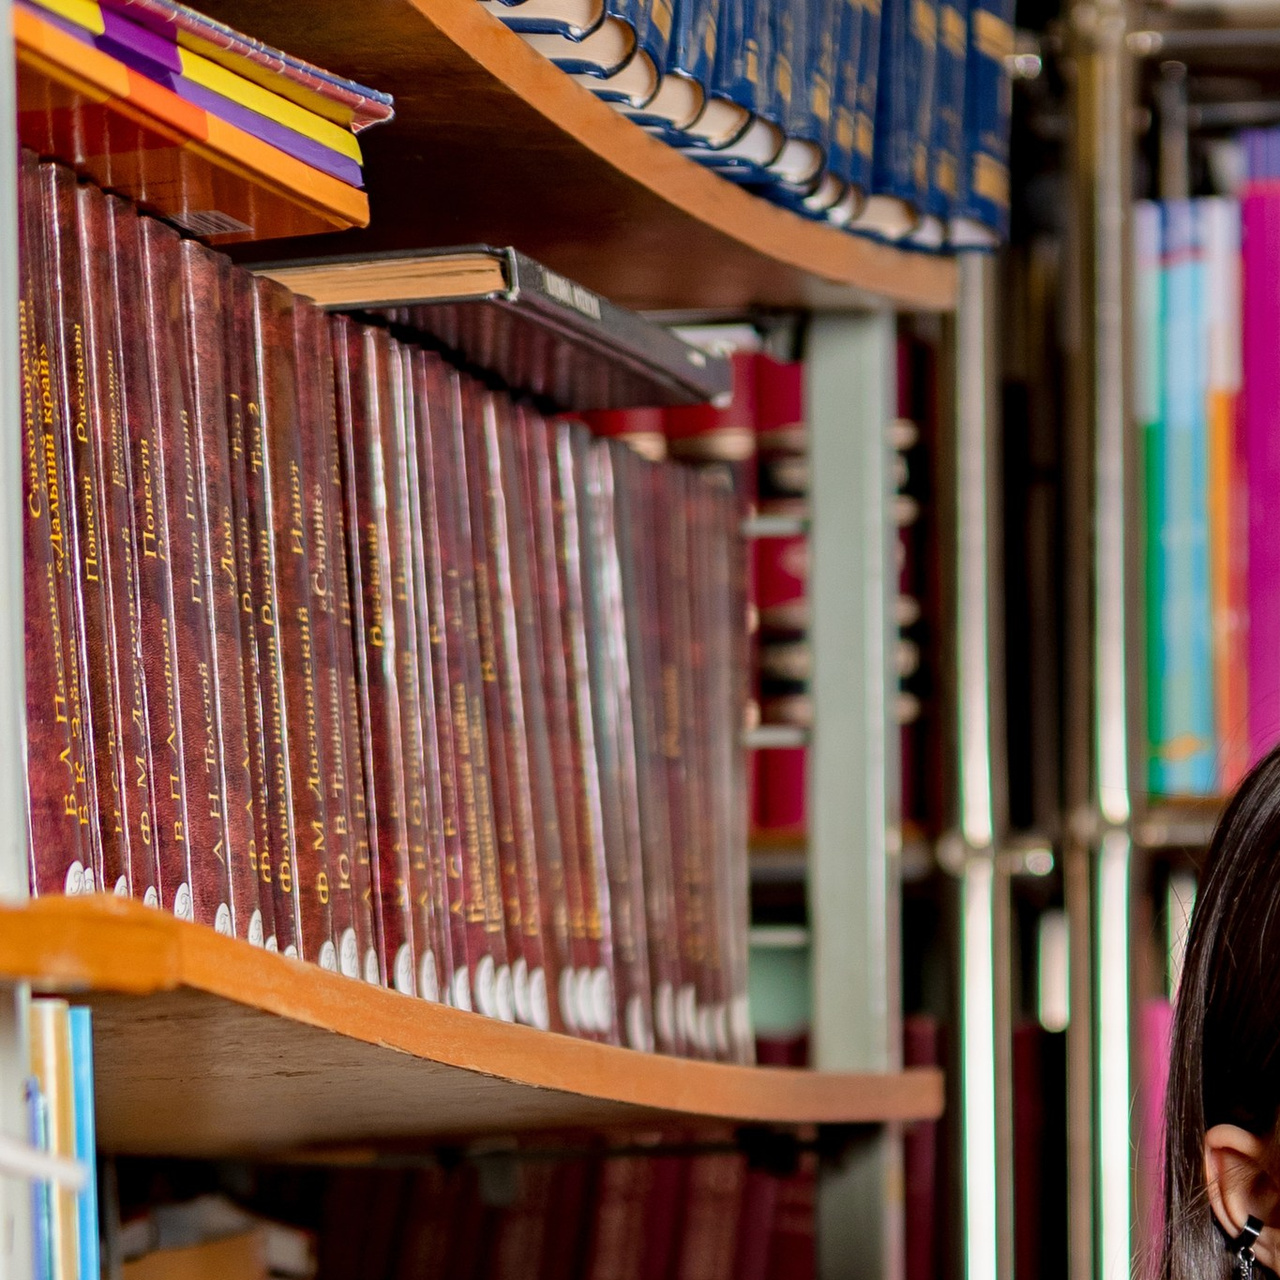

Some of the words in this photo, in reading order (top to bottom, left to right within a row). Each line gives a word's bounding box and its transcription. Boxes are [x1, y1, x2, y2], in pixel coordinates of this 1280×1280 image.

[19, 298, 41, 519] Стихотворения
[38, 341, 55, 424] край»
[74, 322, 89, 443] Рассказы
[105, 348, 116, 401] люди
[248, 401, 260, 417] 2
[109, 407, 123, 486] Бедные
[179, 408, 196, 521] Первый
[250, 426, 263, 474] Том
[43, 433, 65, 574] «Дальний
[84, 476, 99, 581] Повести
[140, 437, 158, 559] Повести
[288, 459, 304, 556] Идиот
[190, 530, 202, 605] Петр
[220, 504, 239, 597] «Дом»
[259, 528, 275, 626] России
[310, 481, 329, 613] «Старик»
[46, 561, 68, 722] Пастернак
[121, 525, 145, 737] Достоевский
[160, 617, 178, 755] Астафьев
[198, 660, 216, 774] Толстой
[267, 635, 282, 744] народов
[295, 605, 323, 802] Достоевский
[140, 802, 151, 846] Ф.
[169, 767, 181, 800] П.
[174, 813, 185, 841] В.
[208, 785, 221, 820] Н.
[275, 752, 291, 893] Фольклор
[310, 810, 326, 852] М.
[212, 831, 225, 866] А.
[315, 863, 330, 905] Ф.
